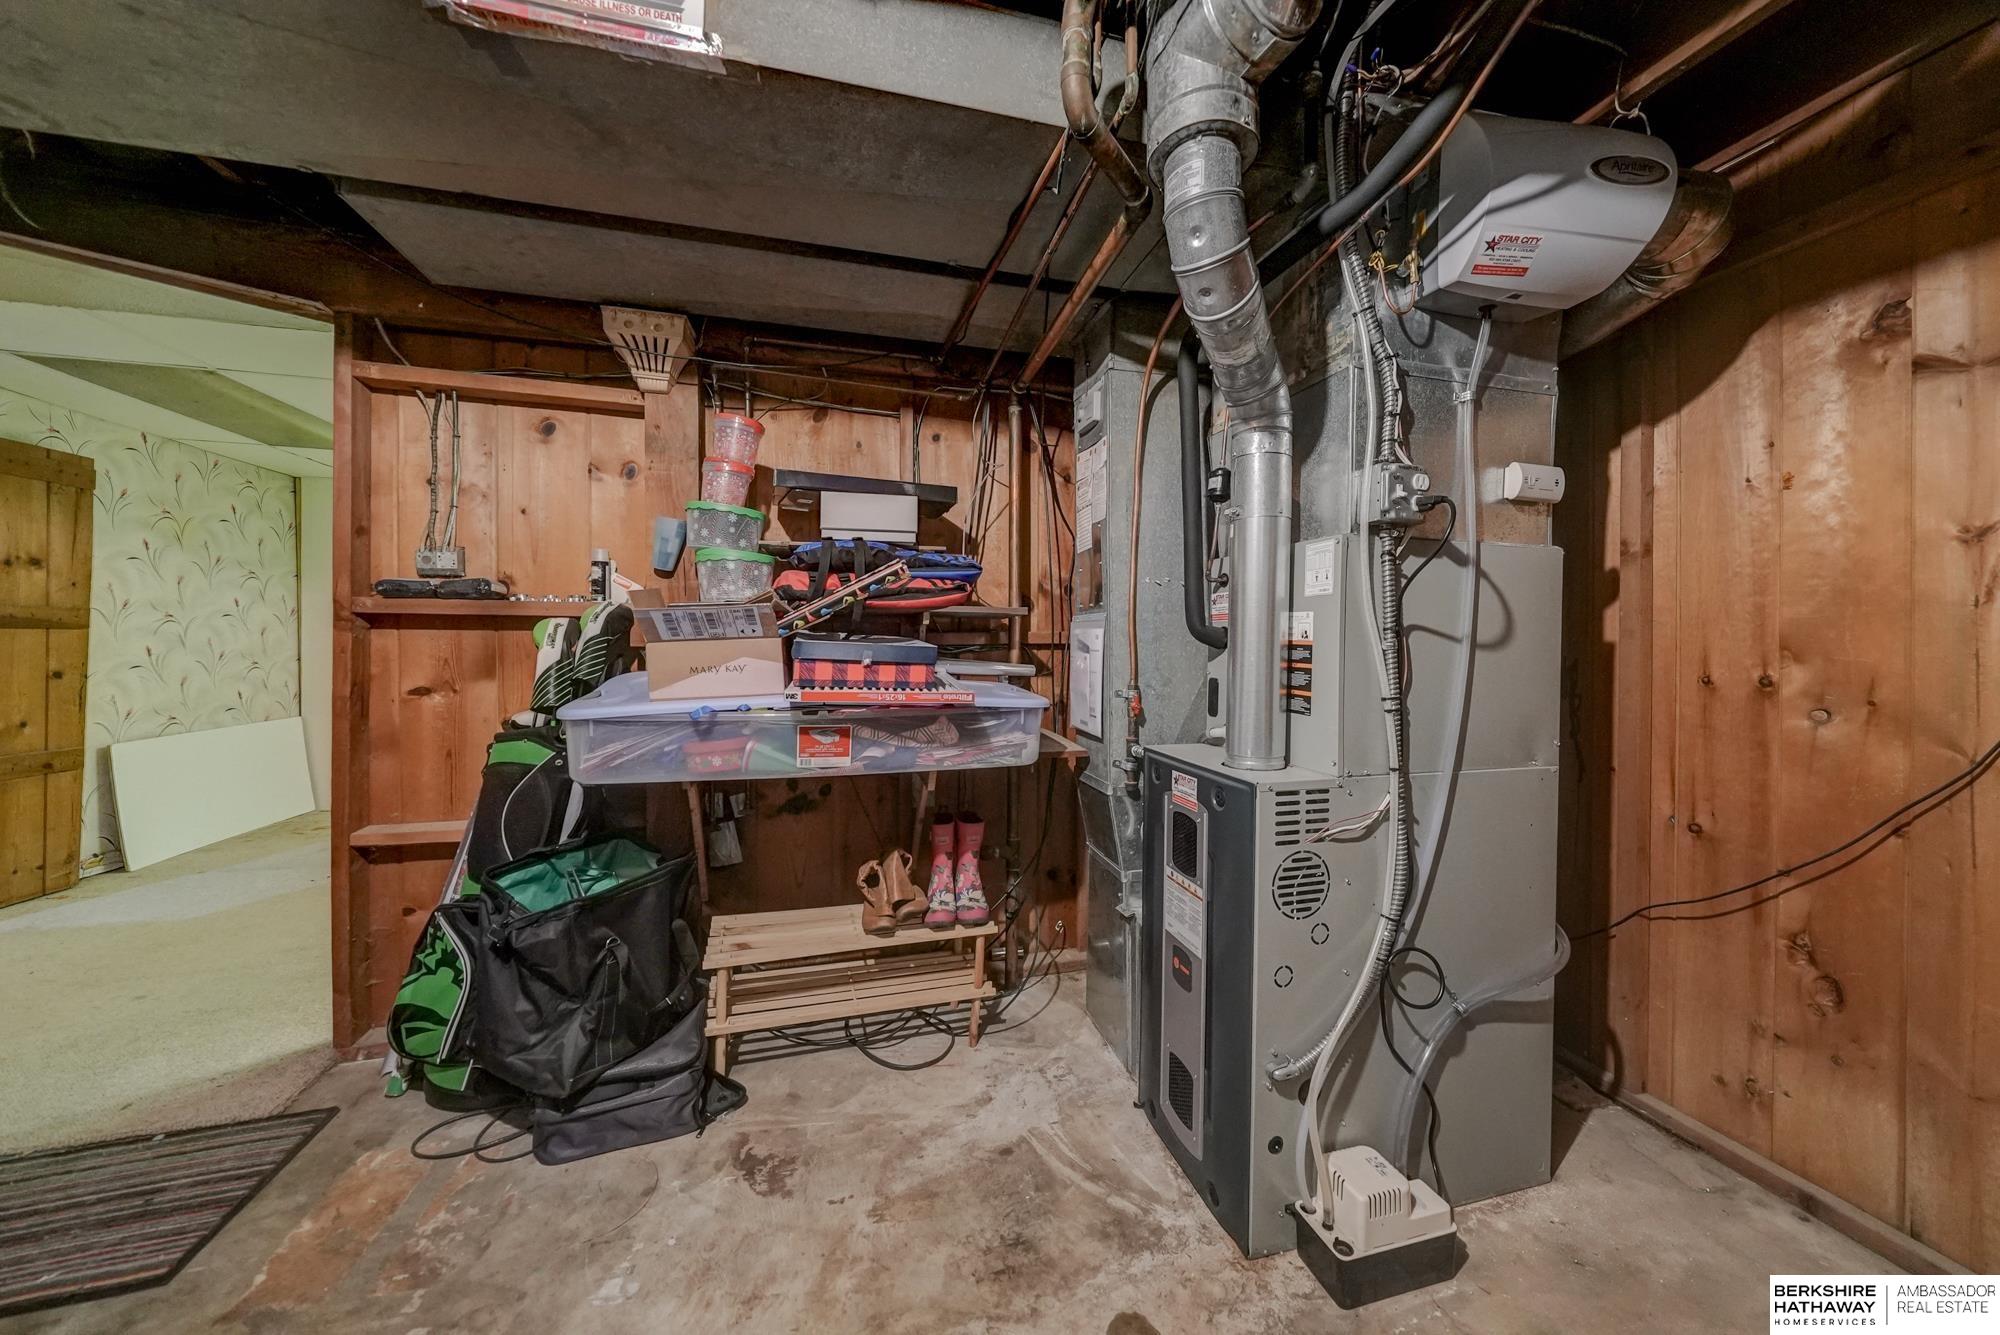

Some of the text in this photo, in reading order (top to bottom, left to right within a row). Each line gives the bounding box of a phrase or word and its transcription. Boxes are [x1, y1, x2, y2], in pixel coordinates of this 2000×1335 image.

[600, 0, 636, 15] ILLNESS
[638, 8, 651, 17] OR
[653, 11, 682, 23] DEATH
[1496, 234, 1543, 246] STAR CITY
[689, 664, 747, 675] MARY KAY
[785, 692, 799, 700] 3M
